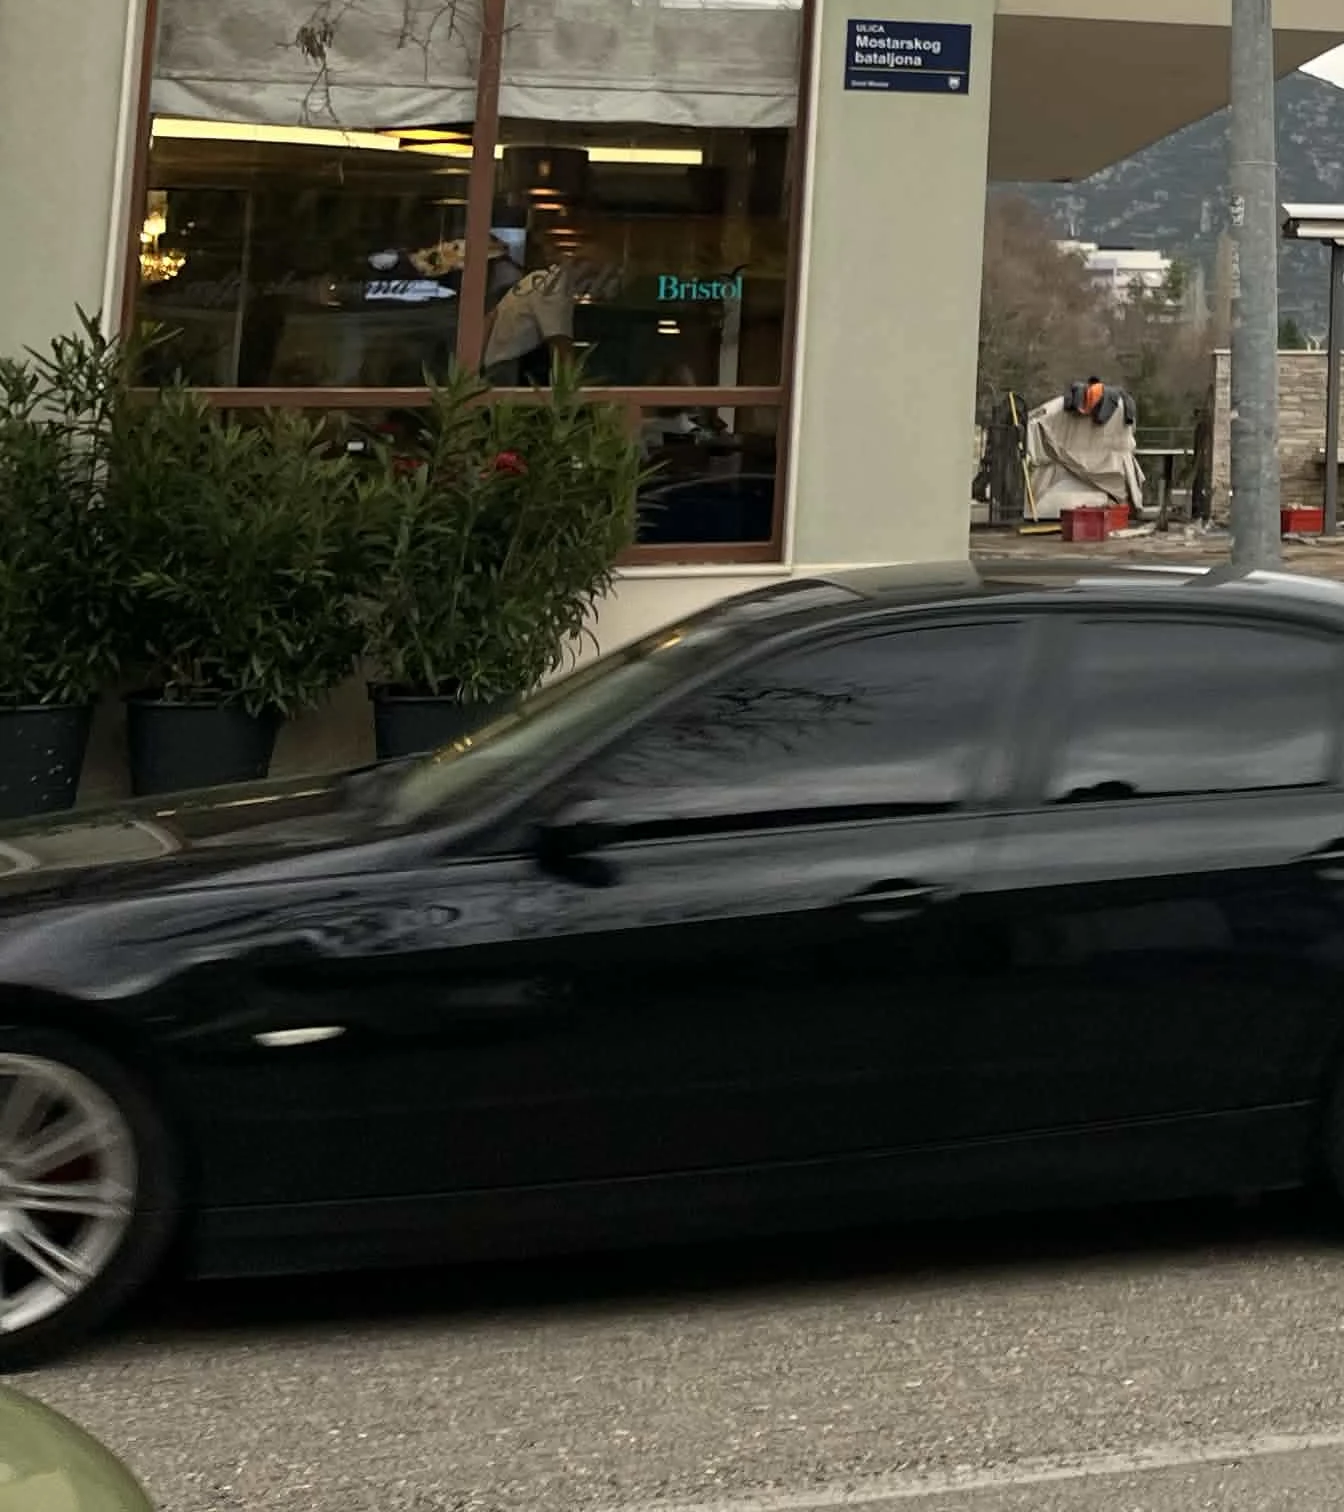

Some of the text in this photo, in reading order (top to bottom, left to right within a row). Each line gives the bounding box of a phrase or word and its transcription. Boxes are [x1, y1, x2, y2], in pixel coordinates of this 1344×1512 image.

[855, 24, 885, 33] ULICA
[855, 34, 941, 54] Mostarskog
[854, 51, 922, 67] bataljona
[656, 274, 743, 300] Bristol
